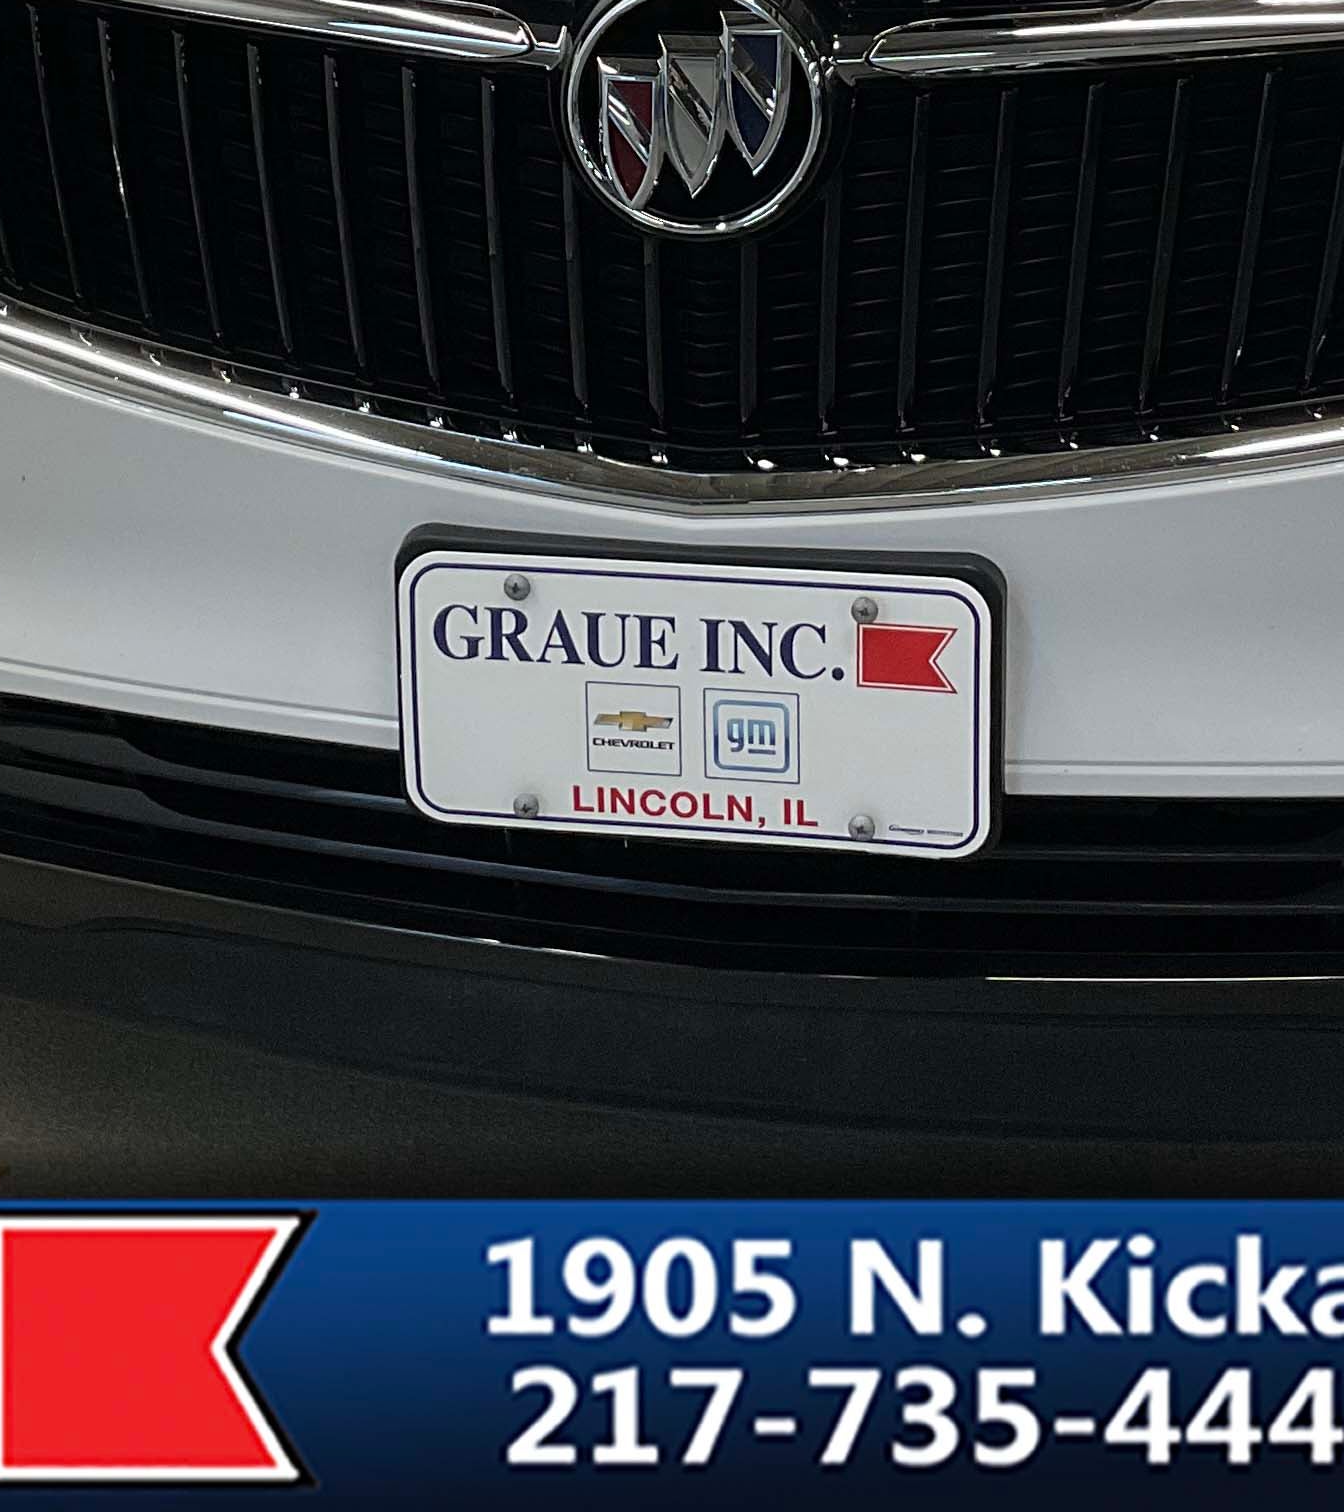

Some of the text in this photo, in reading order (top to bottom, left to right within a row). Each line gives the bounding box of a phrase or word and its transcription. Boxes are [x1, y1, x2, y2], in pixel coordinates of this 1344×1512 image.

[433, 603, 845, 681] GRAUE INC.
[592, 737, 675, 751] CHEVROLET
[726, 718, 777, 754] gm
[572, 785, 818, 828] LINCOLN, IL
